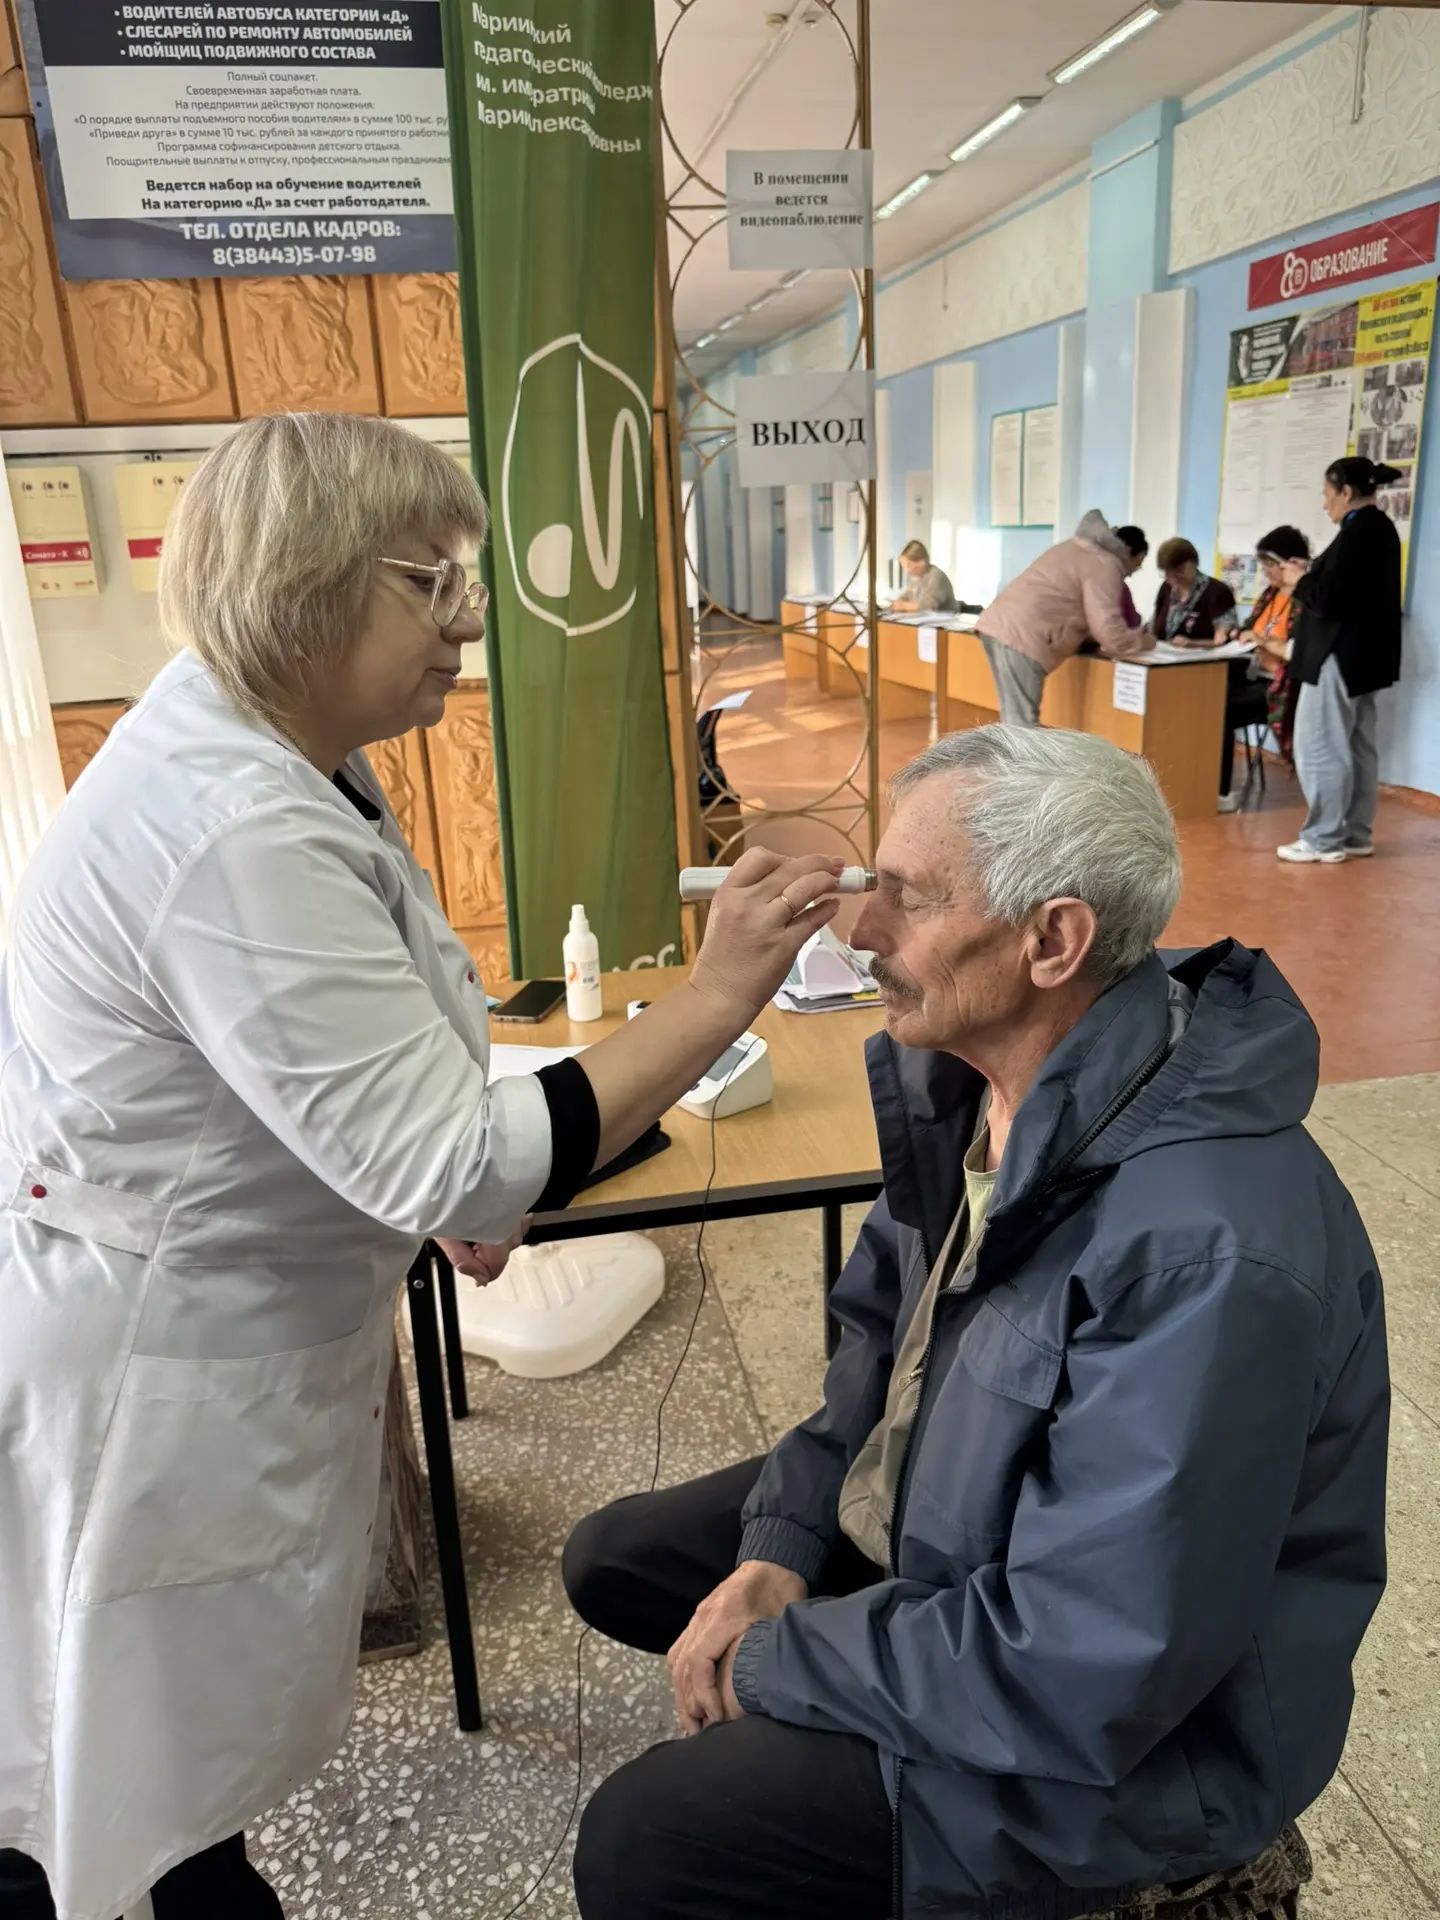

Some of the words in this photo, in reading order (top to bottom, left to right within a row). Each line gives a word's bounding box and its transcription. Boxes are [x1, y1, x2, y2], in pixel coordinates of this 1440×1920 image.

[122, 3, 214, 21] ВОДИТЕЛЕЙ
[217, 7, 293, 21] АВТОБУСА
[295, 8, 380, 22] КАТЕГОРИИ
[382, 10, 409, 24] «Д»
[125, 23, 203, 39] СЛЕСАРЕЙ
[205, 26, 227, 39] ПО
[229, 27, 300, 40] РЕМОНТУ
[302, 26, 413, 41] АВТОМОБИЛЕЙ
[129, 41, 202, 60] МОЙЩИЦ
[204, 45, 310, 60] ПОДВИЖНОГО
[311, 46, 377, 60] СОСТАВА
[227, 71, 267, 81] Полный
[270, 73, 318, 82] соцпакет.
[186, 85, 267, 97] Своевременная
[269, 86, 328, 97] заработная
[330, 88, 361, 96] плата.
[175, 100, 189, 109] На
[191, 102, 259, 113] предприятии
[261, 101, 314, 112] действуют
[316, 103, 376, 111] положения:
[89, 116, 133, 127] порядке
[135, 116, 181, 125] выплаты
[183, 115, 246, 125] подъемного
[248, 114, 290, 124] пособия
[362, 116, 394, 126] сумме
[395, 113, 412, 124] 100
[89, 128, 140, 138] «Приведи
[142, 130, 177, 140] друга»
[188, 130, 221, 140] сумме
[223, 127, 234, 137] 10
[259, 127, 295, 139] рублей
[297, 129, 309, 137] за
[311, 130, 354, 139] каждого
[356, 129, 407, 139] принятого
[158, 142, 217, 154] Программа
[219, 142, 317, 153] софинансирования
[318, 143, 363, 152] детского
[106, 156, 191, 168] Поощрительные
[193, 156, 238, 166] выплаты
[248, 156, 291, 168] отпуску,
[292, 156, 389, 166] профессиональным
[146, 179, 206, 192] Ведется
[209, 178, 253, 193] набор
[256, 181, 273, 190] на
[276, 178, 343, 192] обучение
[346, 177, 421, 191] водителей
[754, 171, 764, 186] В
[142, 198, 160, 210] На
[164, 200, 243, 211] категорию
[246, 197, 272, 210] «Д»
[275, 199, 291, 208] за
[294, 198, 325, 208] счет
[328, 195, 430, 210] работодателя.
[775, 194, 829, 207] ведется
[179, 223, 226, 240] ТЕЛ.
[229, 221, 311, 242] ОТДЕЛА
[314, 220, 401, 240] КАДРОВ:
[213, 245, 376, 267] 8(38443)5-07-98
[1310, 237, 1389, 282] ОБРАЗОВАНИЕ
[752, 418, 867, 448] ВЫХОД
